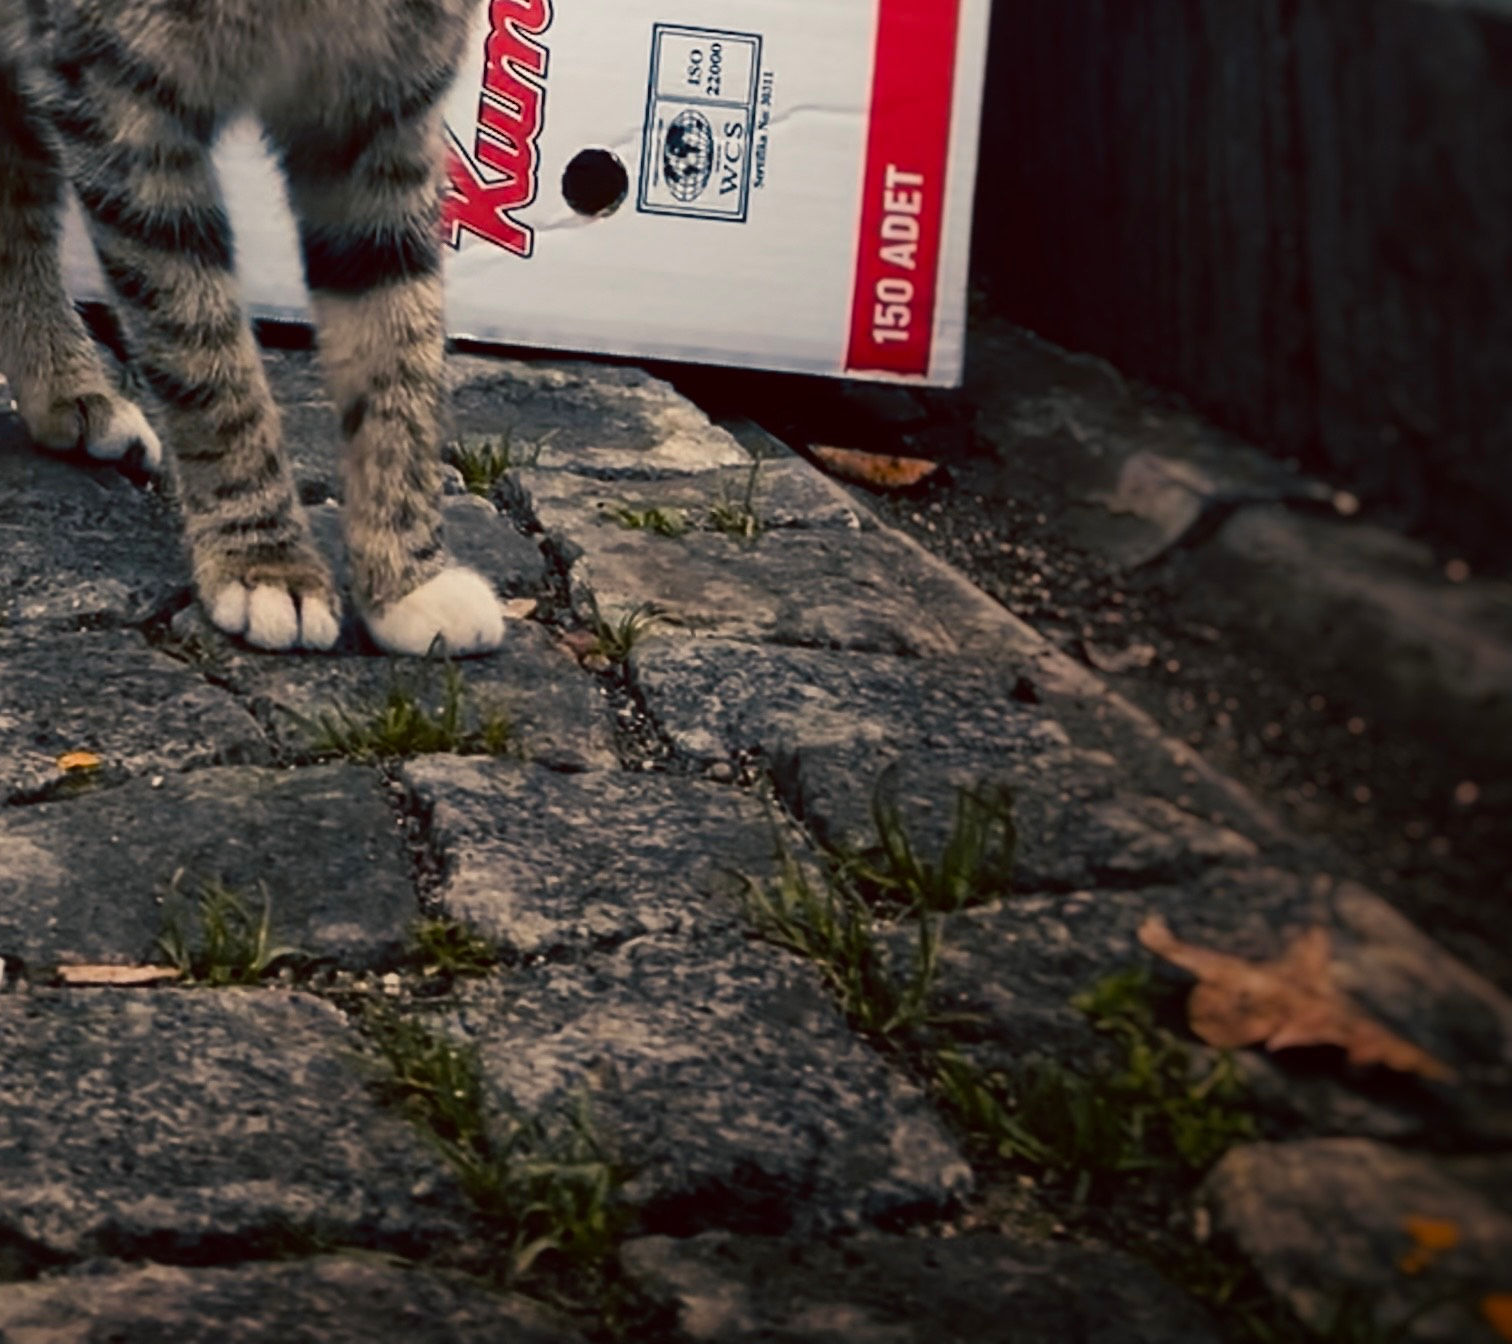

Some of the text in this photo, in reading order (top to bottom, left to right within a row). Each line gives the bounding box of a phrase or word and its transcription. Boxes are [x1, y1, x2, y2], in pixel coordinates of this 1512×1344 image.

[686, 49, 703, 86] ISO
[706, 42, 724, 97] 22000
[718, 121, 743, 197] WCS
[870, 162, 925, 346] 150 ADET
